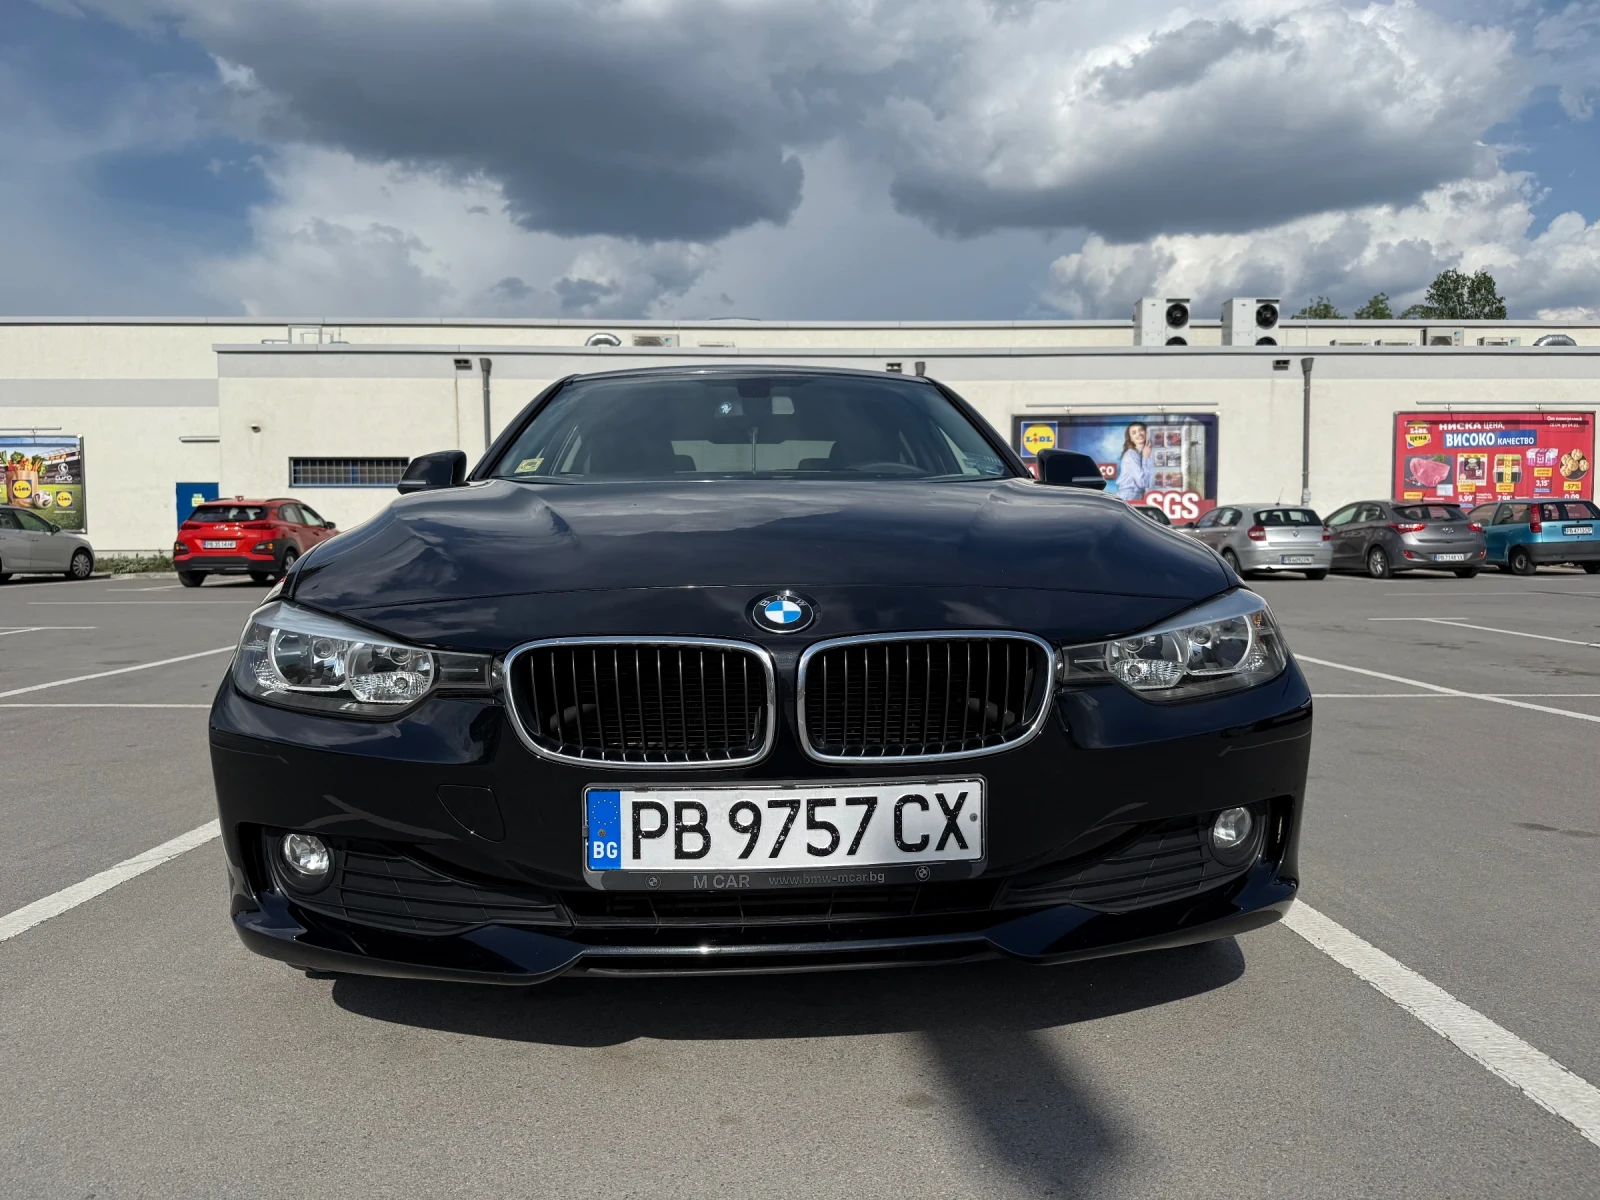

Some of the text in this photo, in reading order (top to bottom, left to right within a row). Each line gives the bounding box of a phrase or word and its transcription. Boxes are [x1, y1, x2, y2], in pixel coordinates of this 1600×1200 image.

[1445, 432, 1534, 447] ВИСОКО КАЧЕСТВО
[759, 595, 807, 607] BMW
[631, 791, 969, 860] PB 9757 CX
[593, 841, 618, 859] BG
[693, 874, 750, 889] M CAR
[768, 870, 885, 886] www.bmw-mcar.bg
